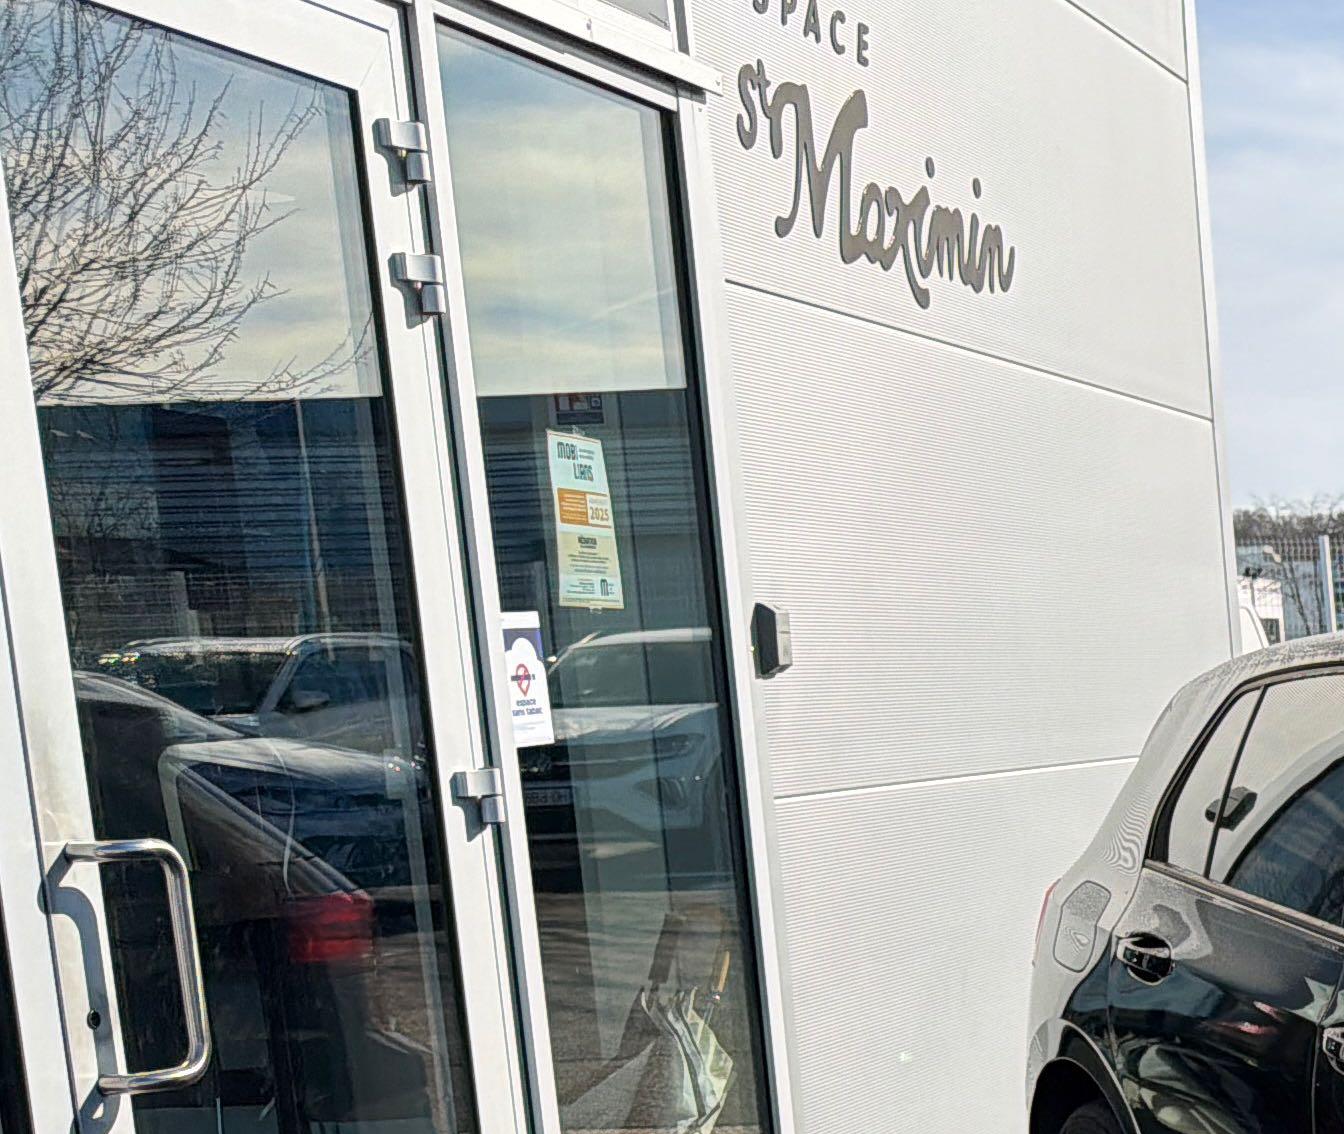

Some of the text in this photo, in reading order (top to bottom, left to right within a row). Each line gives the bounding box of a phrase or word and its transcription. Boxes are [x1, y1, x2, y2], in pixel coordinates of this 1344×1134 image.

[752, 0, 870, 67] PACE
[768, 81, 1015, 309] Maximin
[590, 506, 609, 521] 2025
